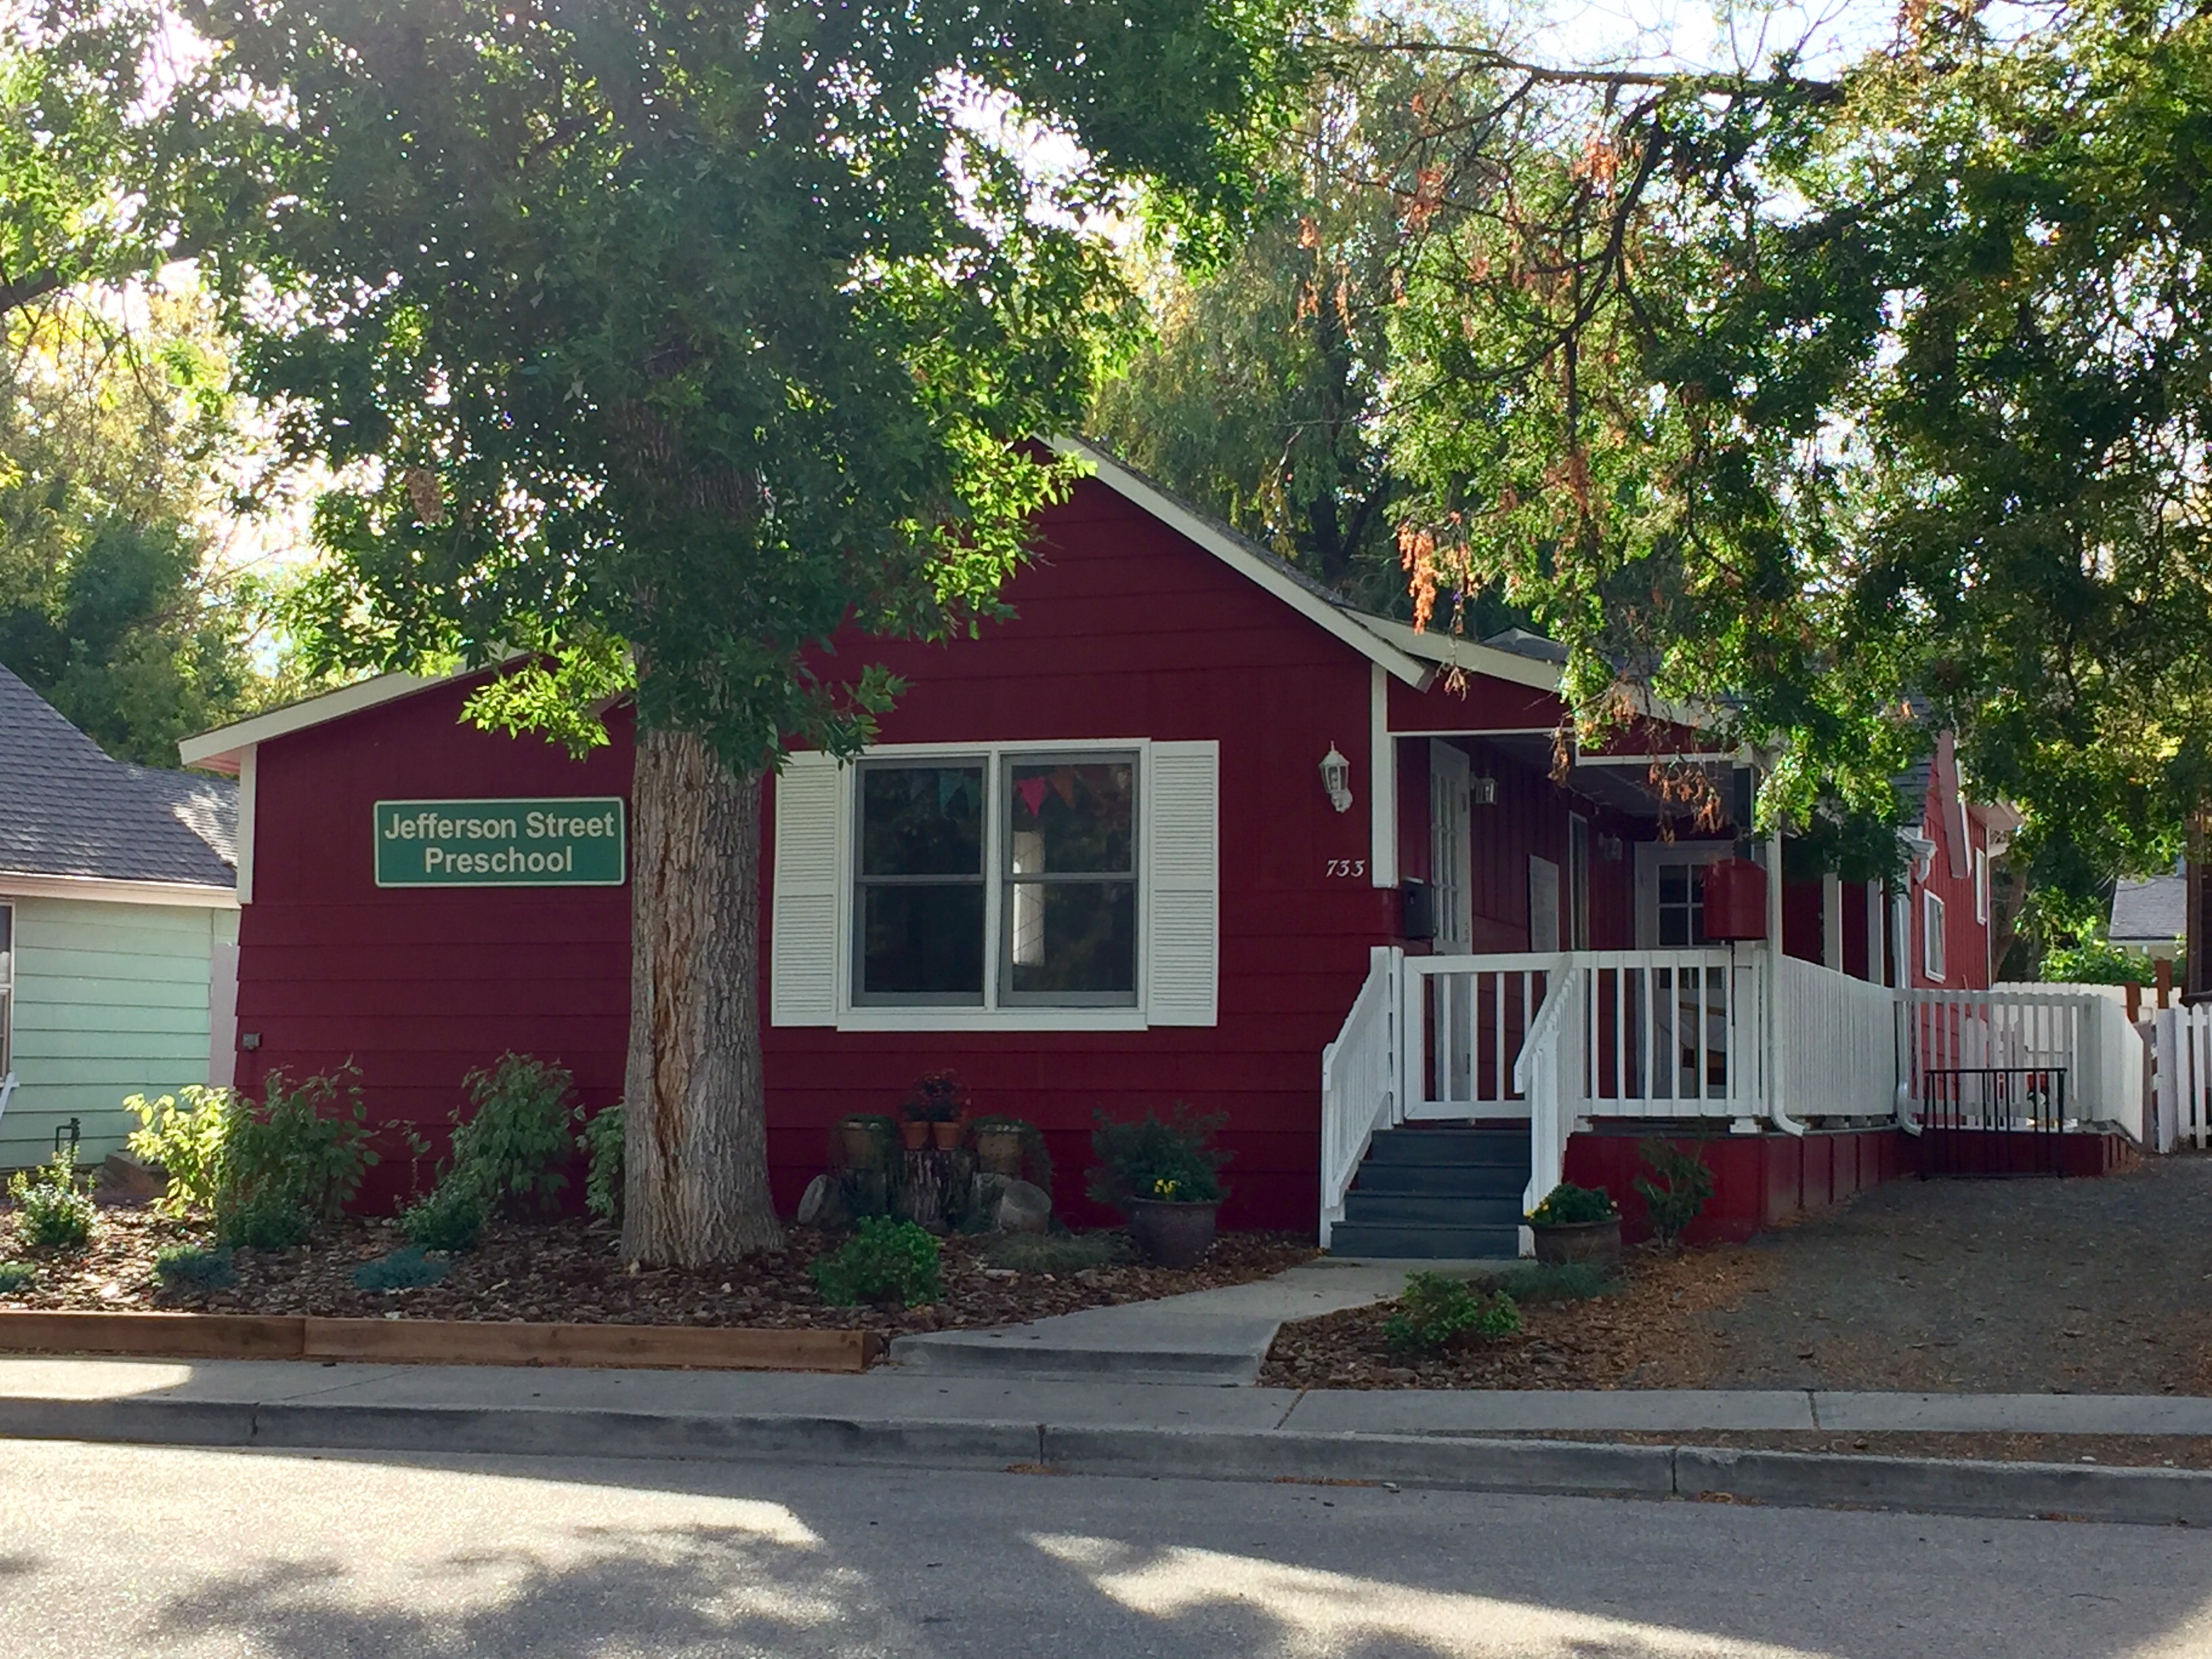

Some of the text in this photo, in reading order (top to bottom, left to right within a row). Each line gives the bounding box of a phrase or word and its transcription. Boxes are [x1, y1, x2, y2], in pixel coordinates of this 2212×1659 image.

[384, 811, 615, 840] Jefferson Street
[425, 845, 573, 874] Preschool
[1326, 859, 1366, 878] 733
